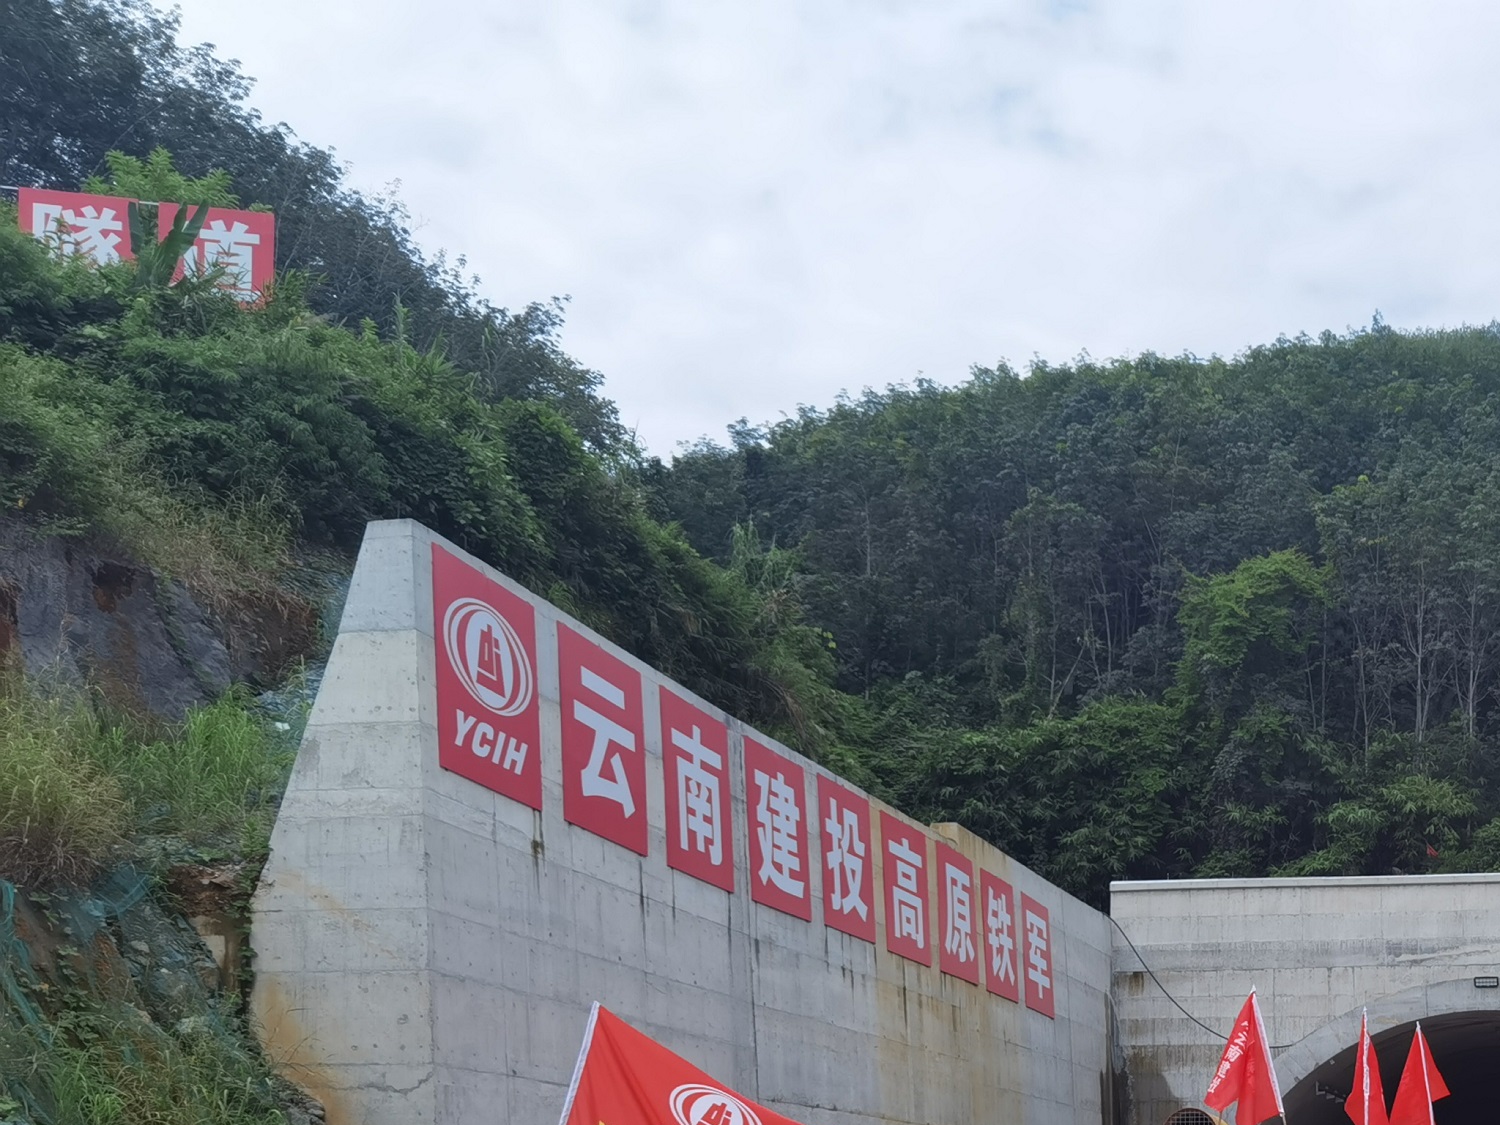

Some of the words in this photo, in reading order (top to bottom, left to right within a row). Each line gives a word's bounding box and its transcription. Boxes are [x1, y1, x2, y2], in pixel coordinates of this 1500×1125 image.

[453, 708, 528, 775] YCIH
[573, 665, 1051, 1000] 云南建投高原铁军
